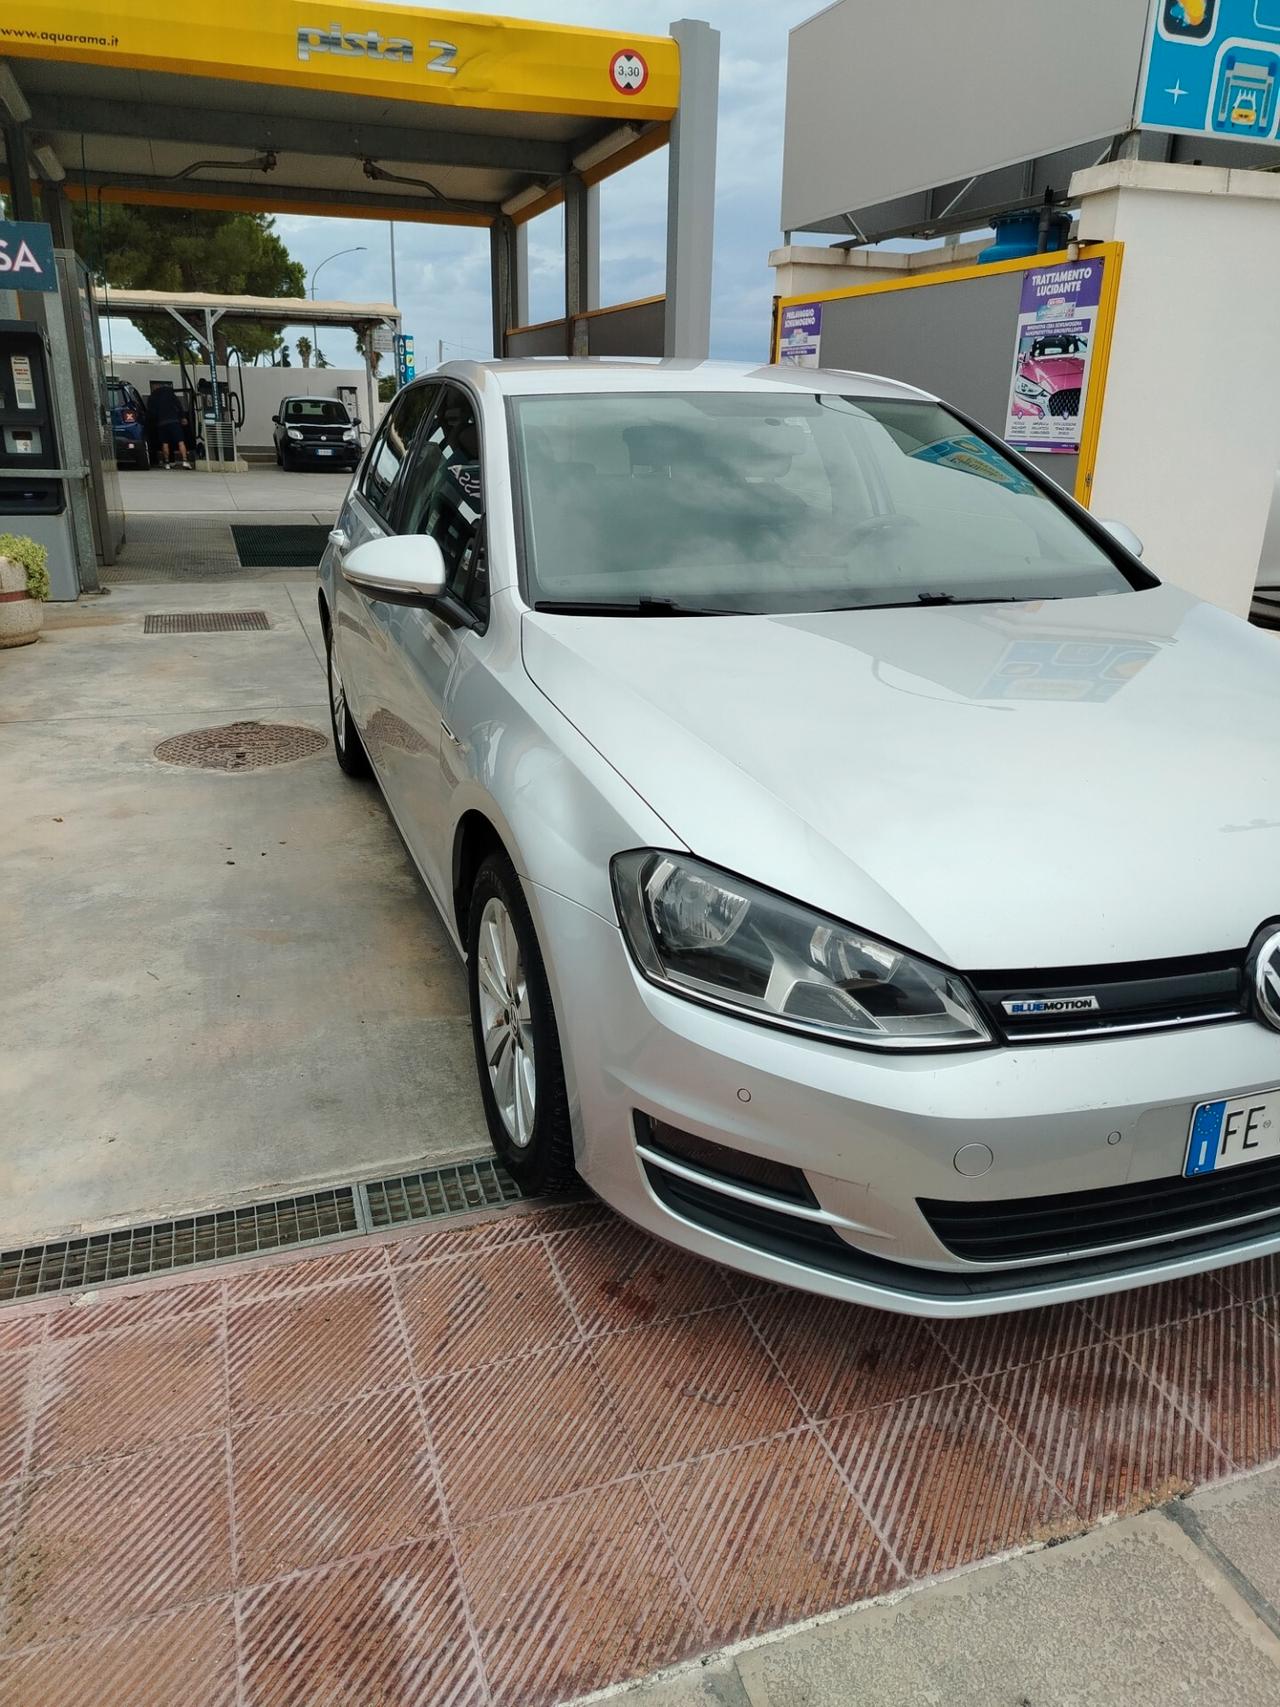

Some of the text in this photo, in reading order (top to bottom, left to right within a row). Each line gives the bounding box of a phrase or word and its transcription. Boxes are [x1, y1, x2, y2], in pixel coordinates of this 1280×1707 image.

[1, 28, 119, 45] www.aquarama.it
[297, 23, 457, 74] pista 2
[1032, 267, 1092, 286] TRATTAMENTO
[1036, 281, 1081, 296] LUCIDANTE
[1012, 1000, 1092, 1012] BLUEMOTION
[1221, 1105, 1266, 1155] FE
